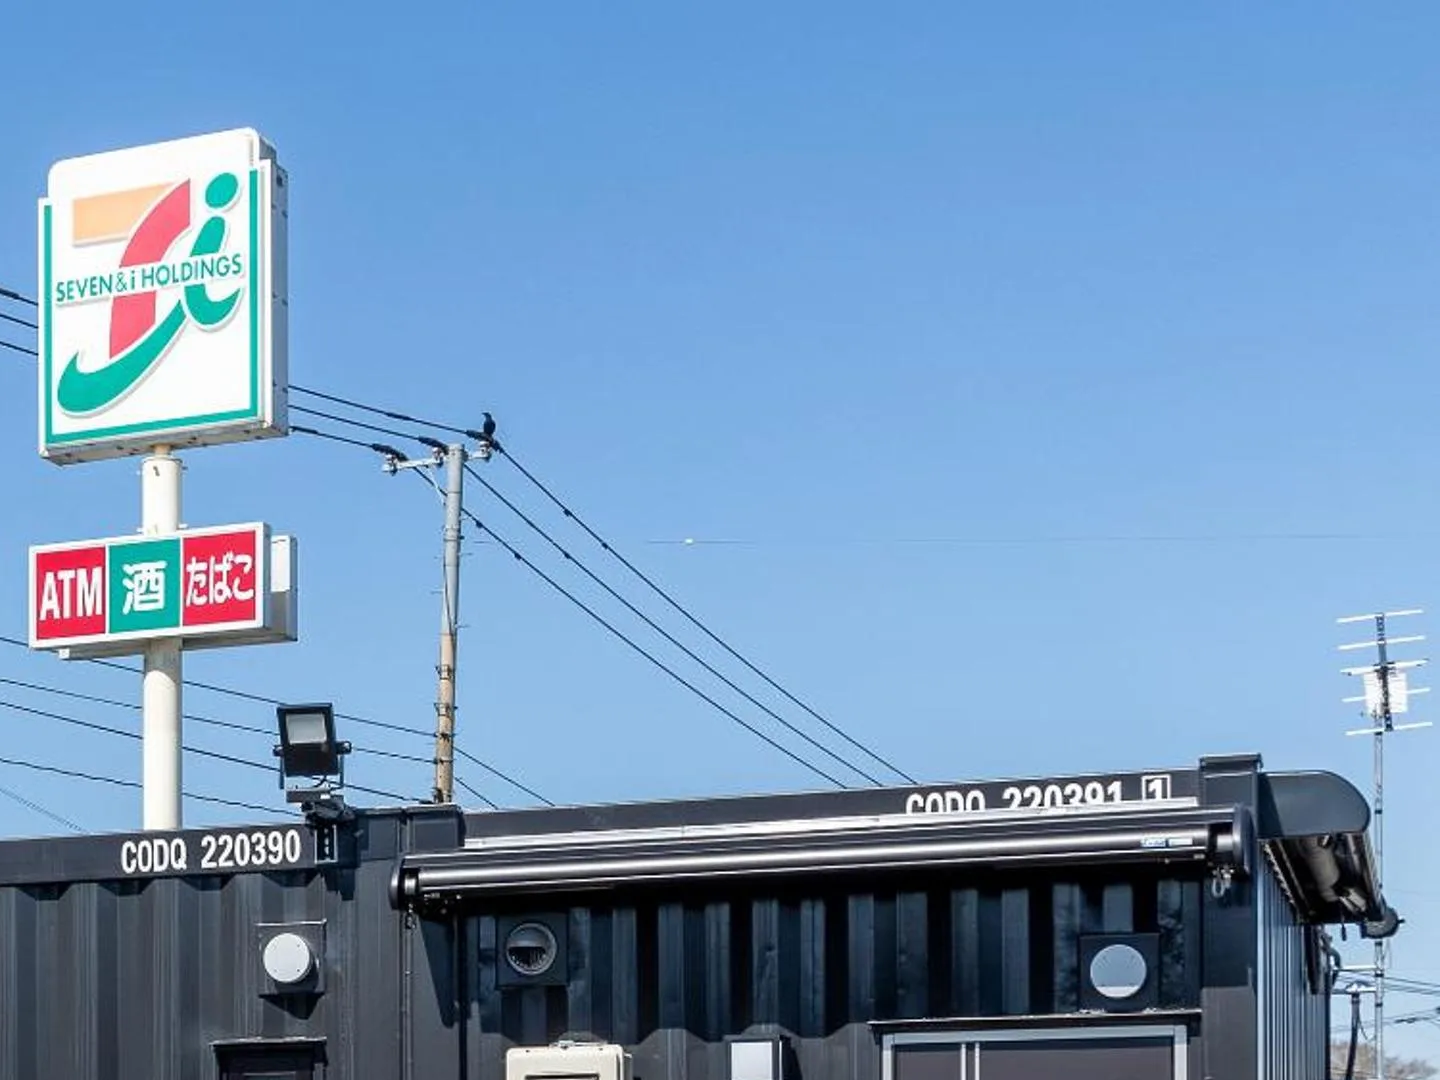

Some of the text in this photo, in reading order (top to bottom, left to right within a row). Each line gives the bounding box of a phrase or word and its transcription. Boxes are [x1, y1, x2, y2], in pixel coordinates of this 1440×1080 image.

[141, 253, 242, 289] HOLDINGS
[39, 566, 103, 621] ATM
[122, 560, 167, 615] 酒
[186, 551, 254, 607] たばこ
[121, 838, 187, 874] CODQ
[201, 828, 301, 869] 220390
